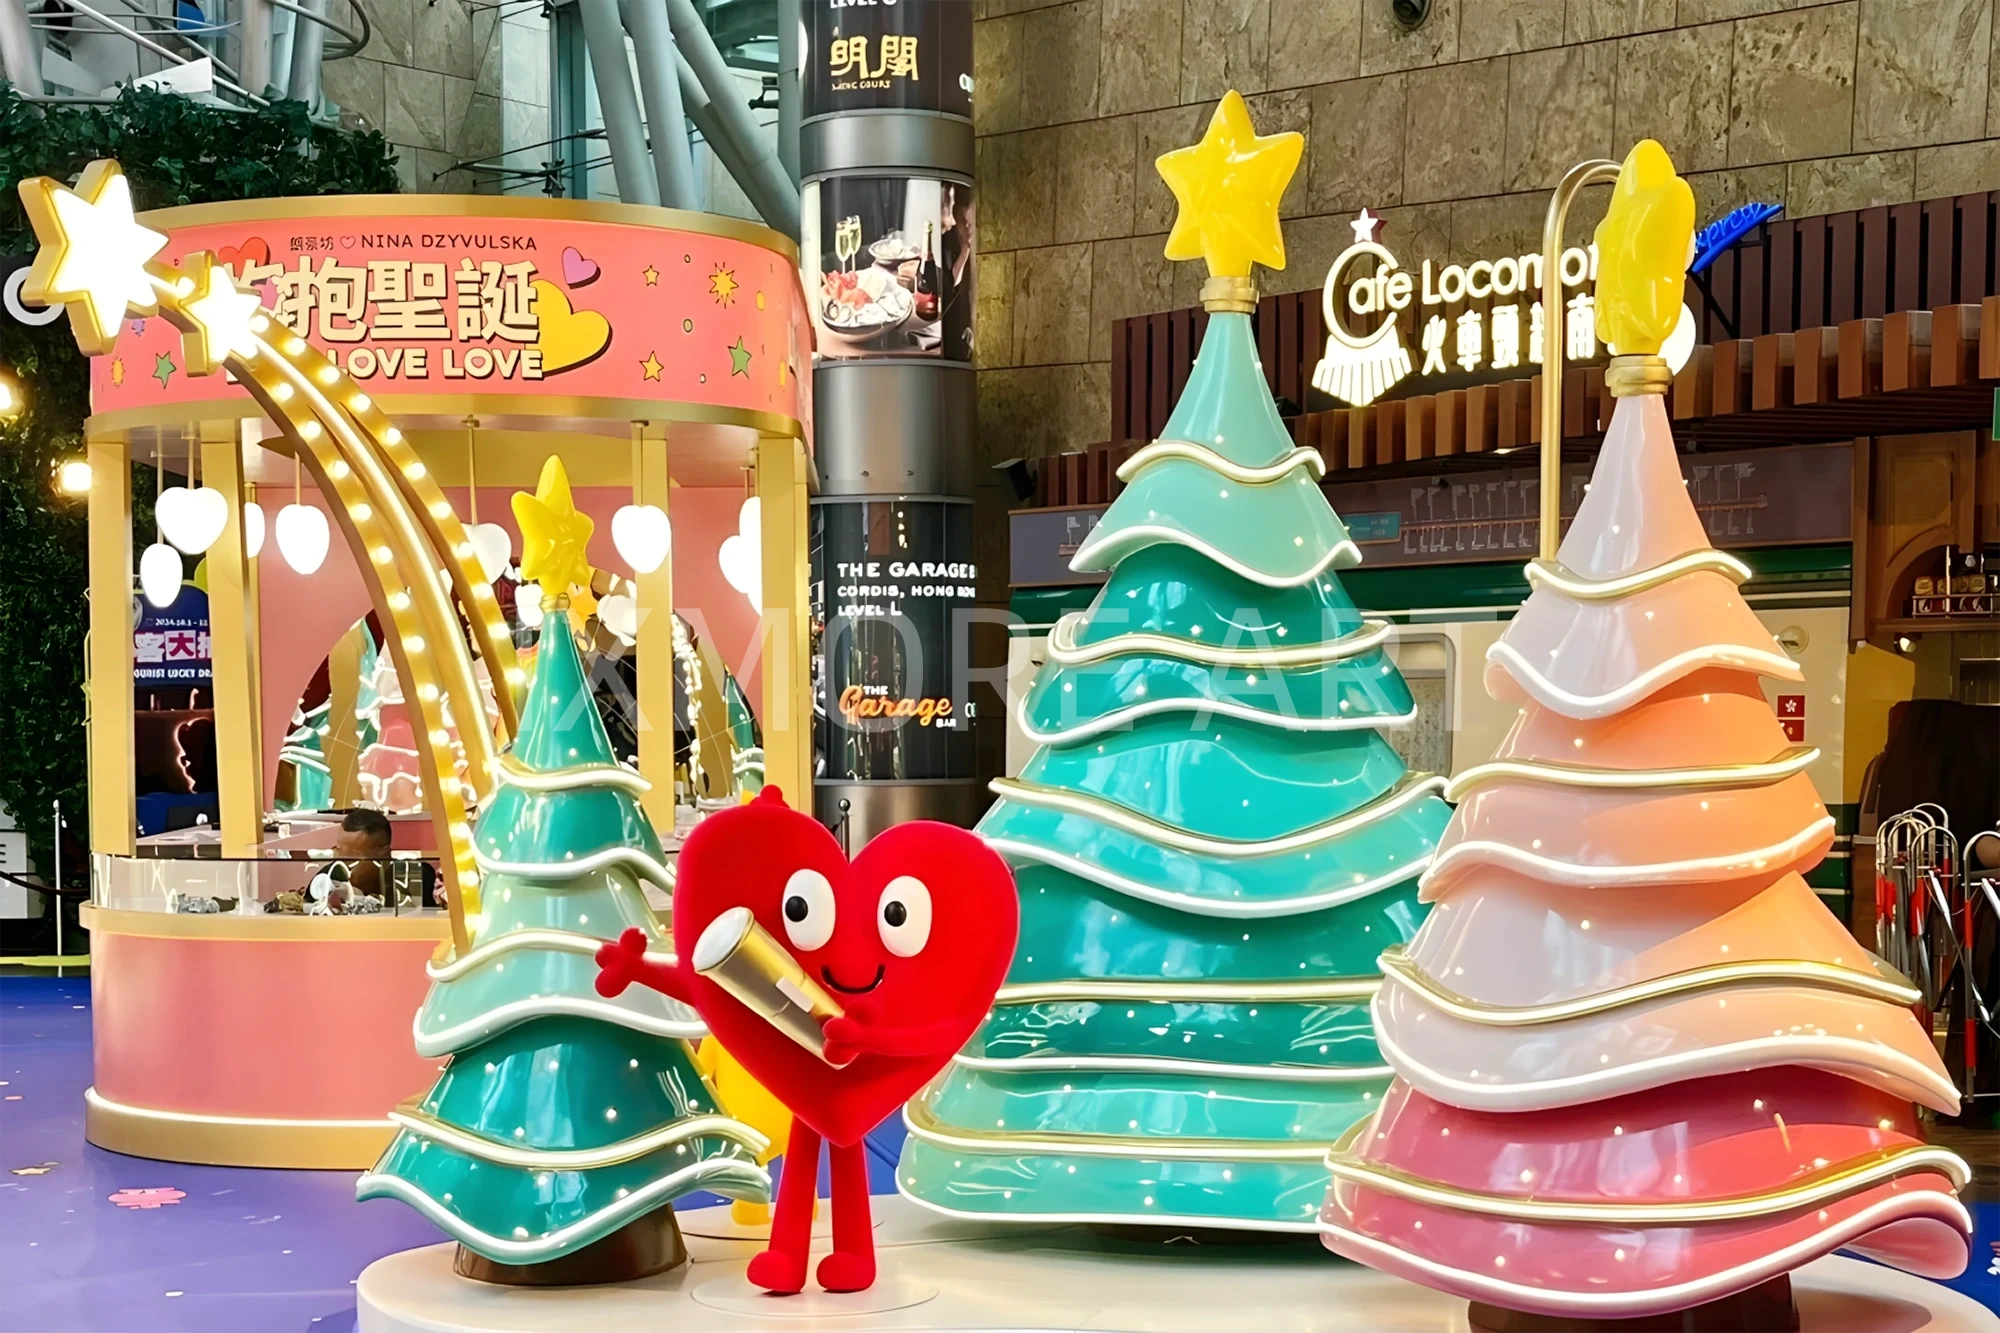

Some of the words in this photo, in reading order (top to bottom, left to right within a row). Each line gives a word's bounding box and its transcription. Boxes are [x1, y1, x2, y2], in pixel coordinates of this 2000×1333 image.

[361, 235, 414, 249] NINA
[421, 235, 538, 251] DZYVULSKA
[442, 347, 544, 379] LOVE
[837, 563, 881, 578] THE
[888, 562, 968, 579] GARAGE
[837, 585, 905, 598] CORDIS,
[911, 585, 955, 598] HONG
[838, 604, 885, 617] LEVEL
[890, 601, 903, 616] L
[863, 685, 888, 695] THE
[839, 685, 953, 726] Garage
[936, 718, 956, 728] BAR
